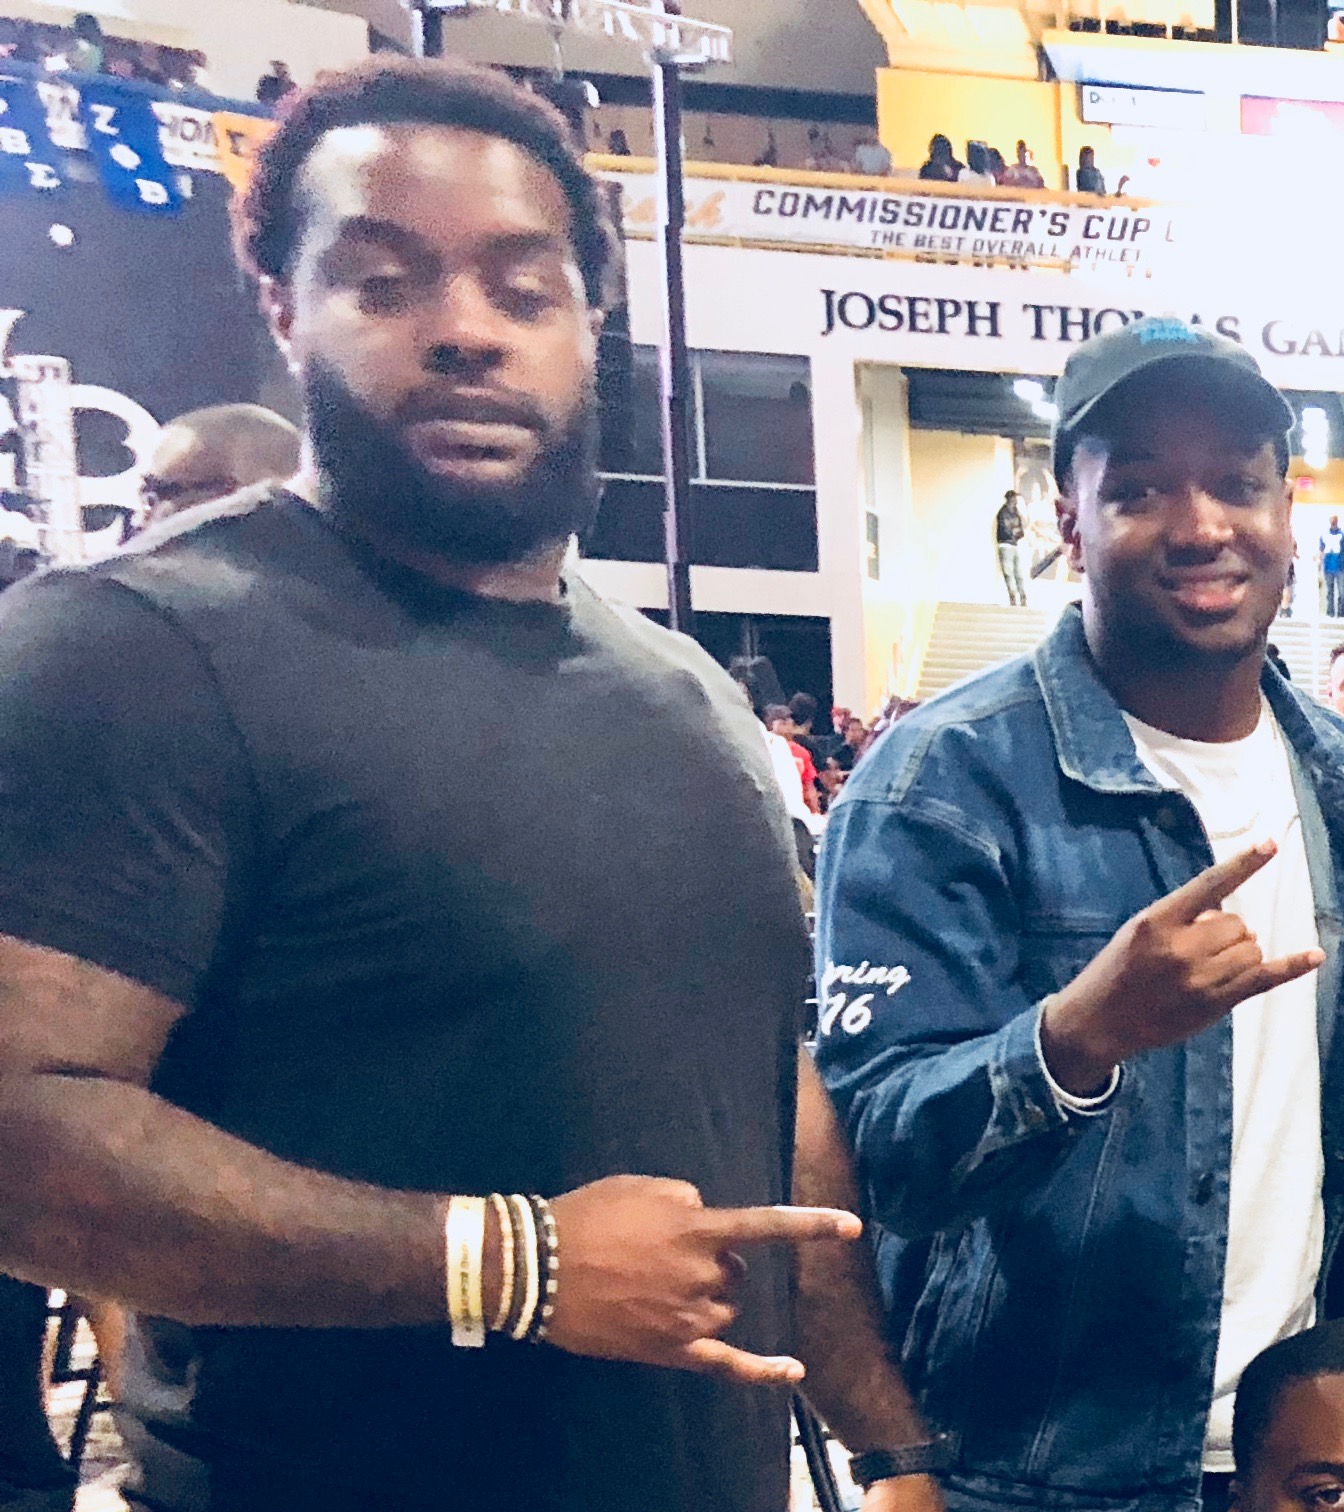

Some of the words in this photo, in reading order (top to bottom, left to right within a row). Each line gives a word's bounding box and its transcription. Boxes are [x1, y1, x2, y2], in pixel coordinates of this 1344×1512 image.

[752, 189, 1070, 237] COMMISSIONER'S
[1082, 214, 1151, 242] CUP
[871, 230, 908, 247] THE
[913, 233, 966, 251] BEST
[972, 238, 1058, 258] OVERALL
[820, 289, 1002, 338] JOSEPH
[1022, 303, 1243, 344] THOS
